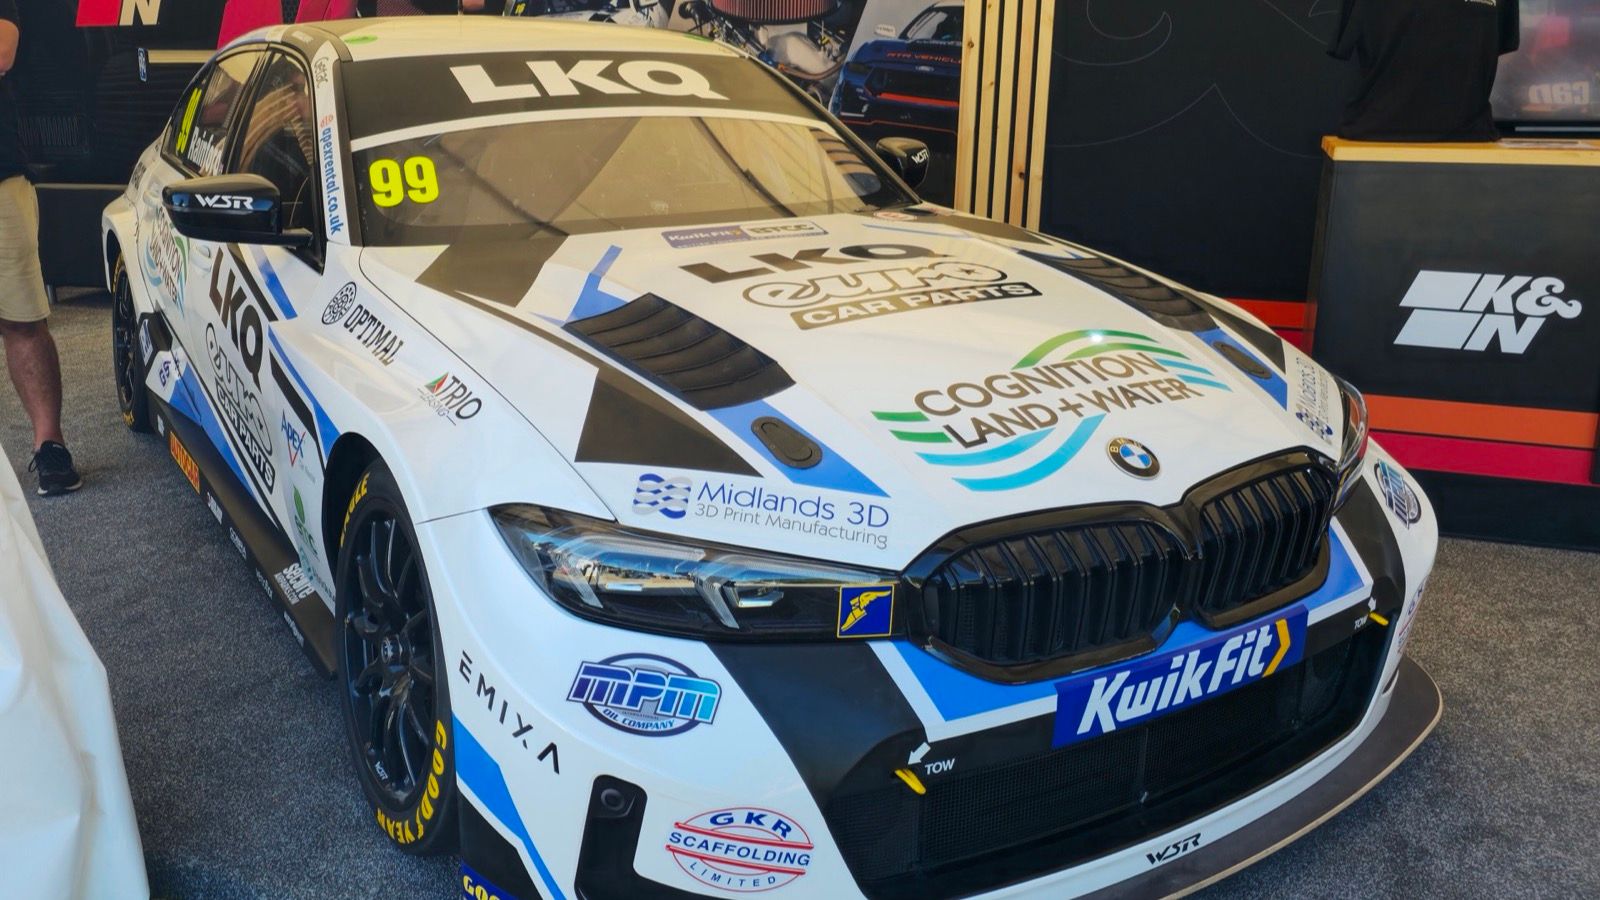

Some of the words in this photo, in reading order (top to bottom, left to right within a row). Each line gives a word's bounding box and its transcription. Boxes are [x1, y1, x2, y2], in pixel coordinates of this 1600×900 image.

[450, 60, 730, 103] LKQ
[195, 193, 254, 210] WSR
[319, 127, 344, 236] apexrental.co.uk
[369, 156, 439, 208] 99
[679, 244, 955, 284] LKQ
[209, 247, 264, 394] LKQ
[802, 301, 900, 325] CAR
[900, 284, 1031, 308] PARTS
[343, 304, 404, 367] OPTIMAL
[1463, 313, 1547, 354] N
[436, 376, 482, 420] TRIO
[914, 352, 1169, 417] COGNITION
[216, 386, 239, 430] CAR
[239, 421, 275, 493] PARTS
[697, 481, 836, 521] Midlands
[846, 502, 889, 528] 3D
[695, 503, 719, 518] 3D
[724, 508, 760, 526] Print
[765, 515, 888, 550] Manufacturing
[602, 708, 618, 722] OIL
[622, 717, 675, 730] COMPANY
[925, 758, 955, 775] TOW
[709, 811, 792, 839] GKR
[669, 832, 811, 867] SCAFFOLDING
[1146, 833, 1201, 865] WSR
[690, 861, 776, 887] LIMITED
